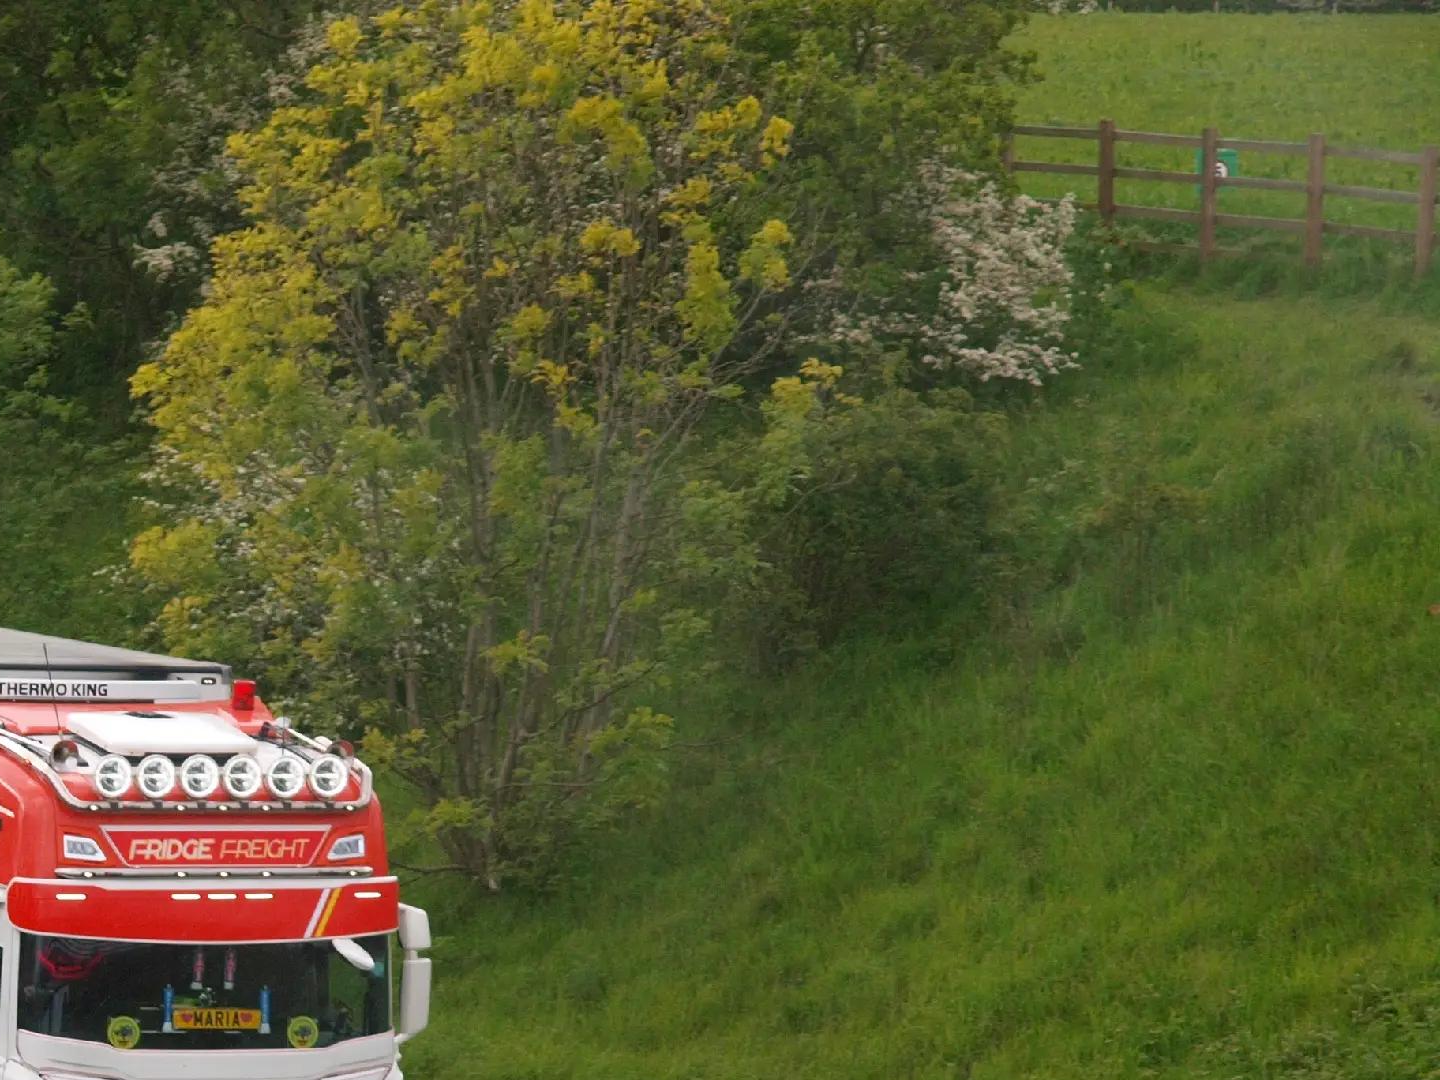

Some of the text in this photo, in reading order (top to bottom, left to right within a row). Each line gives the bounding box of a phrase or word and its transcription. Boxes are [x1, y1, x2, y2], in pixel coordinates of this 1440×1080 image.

[71, 683, 108, 697] KING
[129, 838, 310, 860] FRIDGE FREIGHT
[193, 1010, 242, 1028] MARIA
